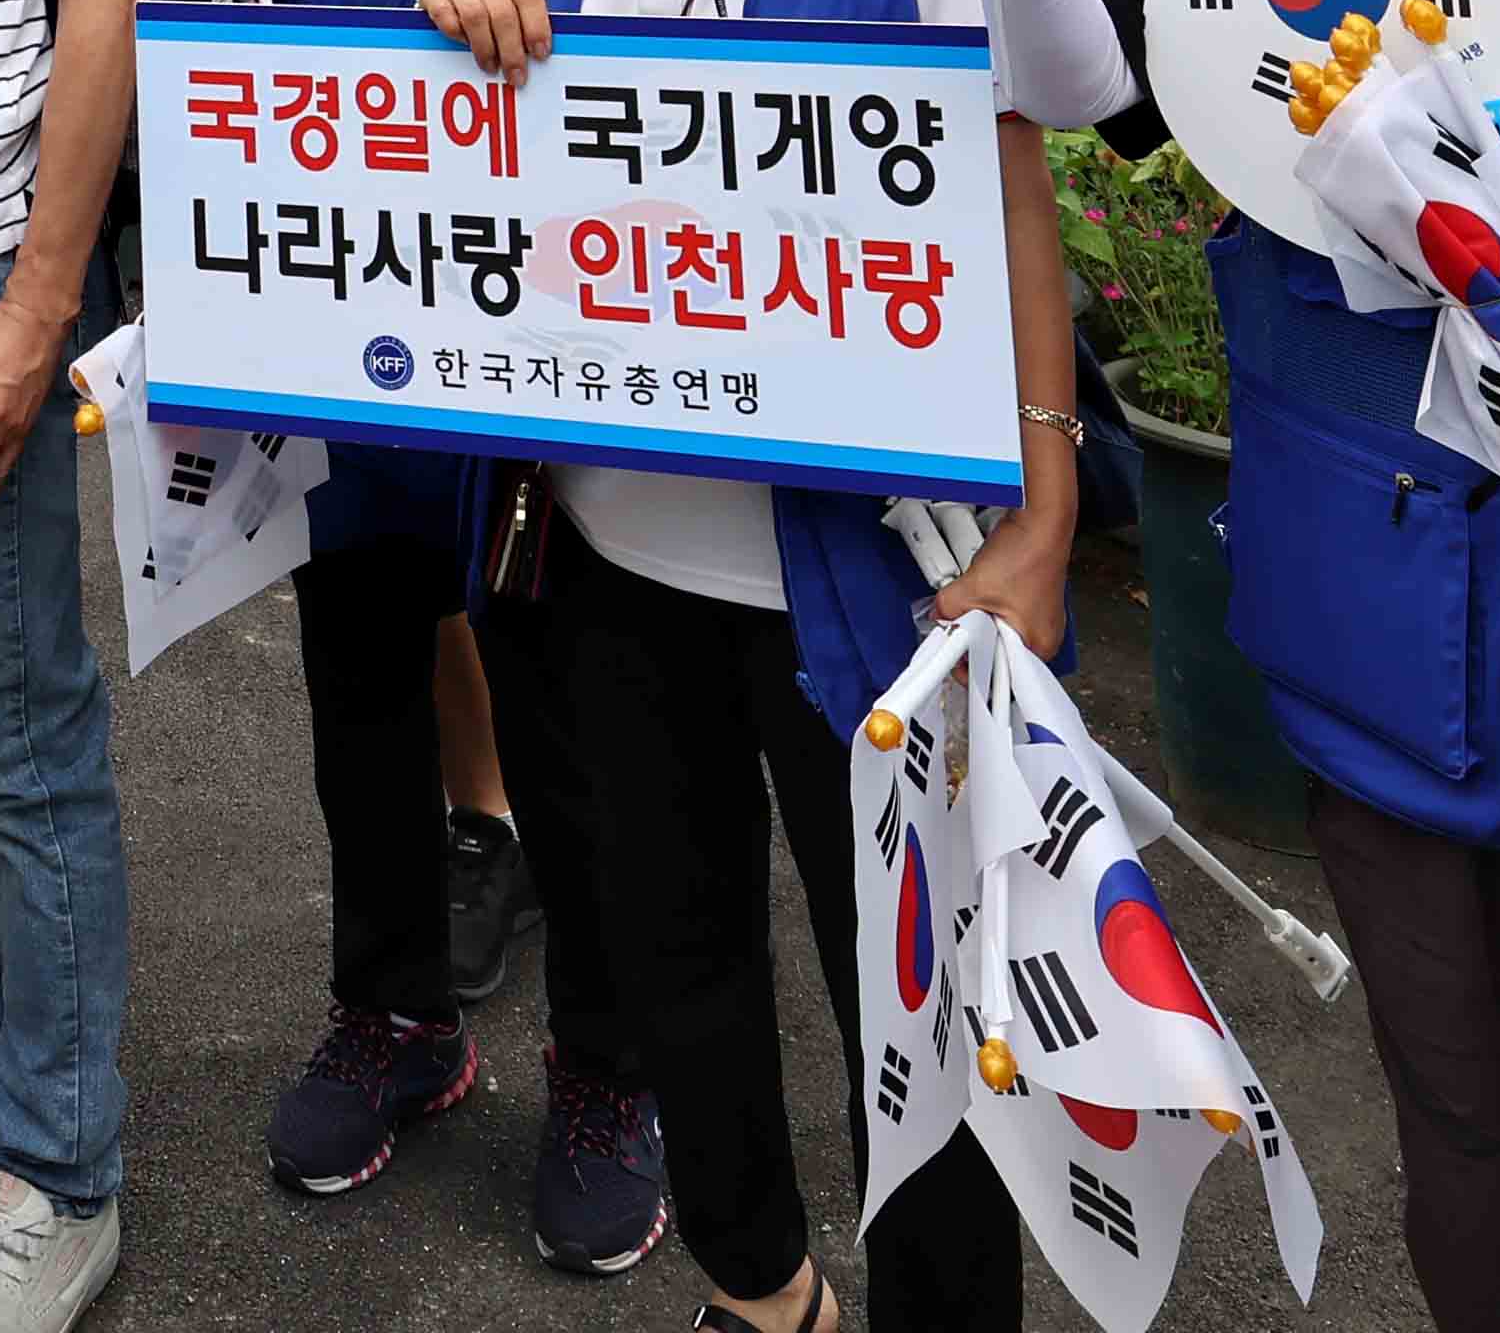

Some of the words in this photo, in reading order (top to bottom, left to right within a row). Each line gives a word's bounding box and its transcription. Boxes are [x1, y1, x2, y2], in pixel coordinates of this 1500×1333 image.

[187, 70, 519, 178] 국경일에
[563, 85, 945, 207] 국기게양
[193, 197, 534, 318] 나라사랑
[569, 218, 954, 349] 인천사랑
[372, 355, 405, 373] KFF
[432, 348, 760, 415] 한국자유총연맹
